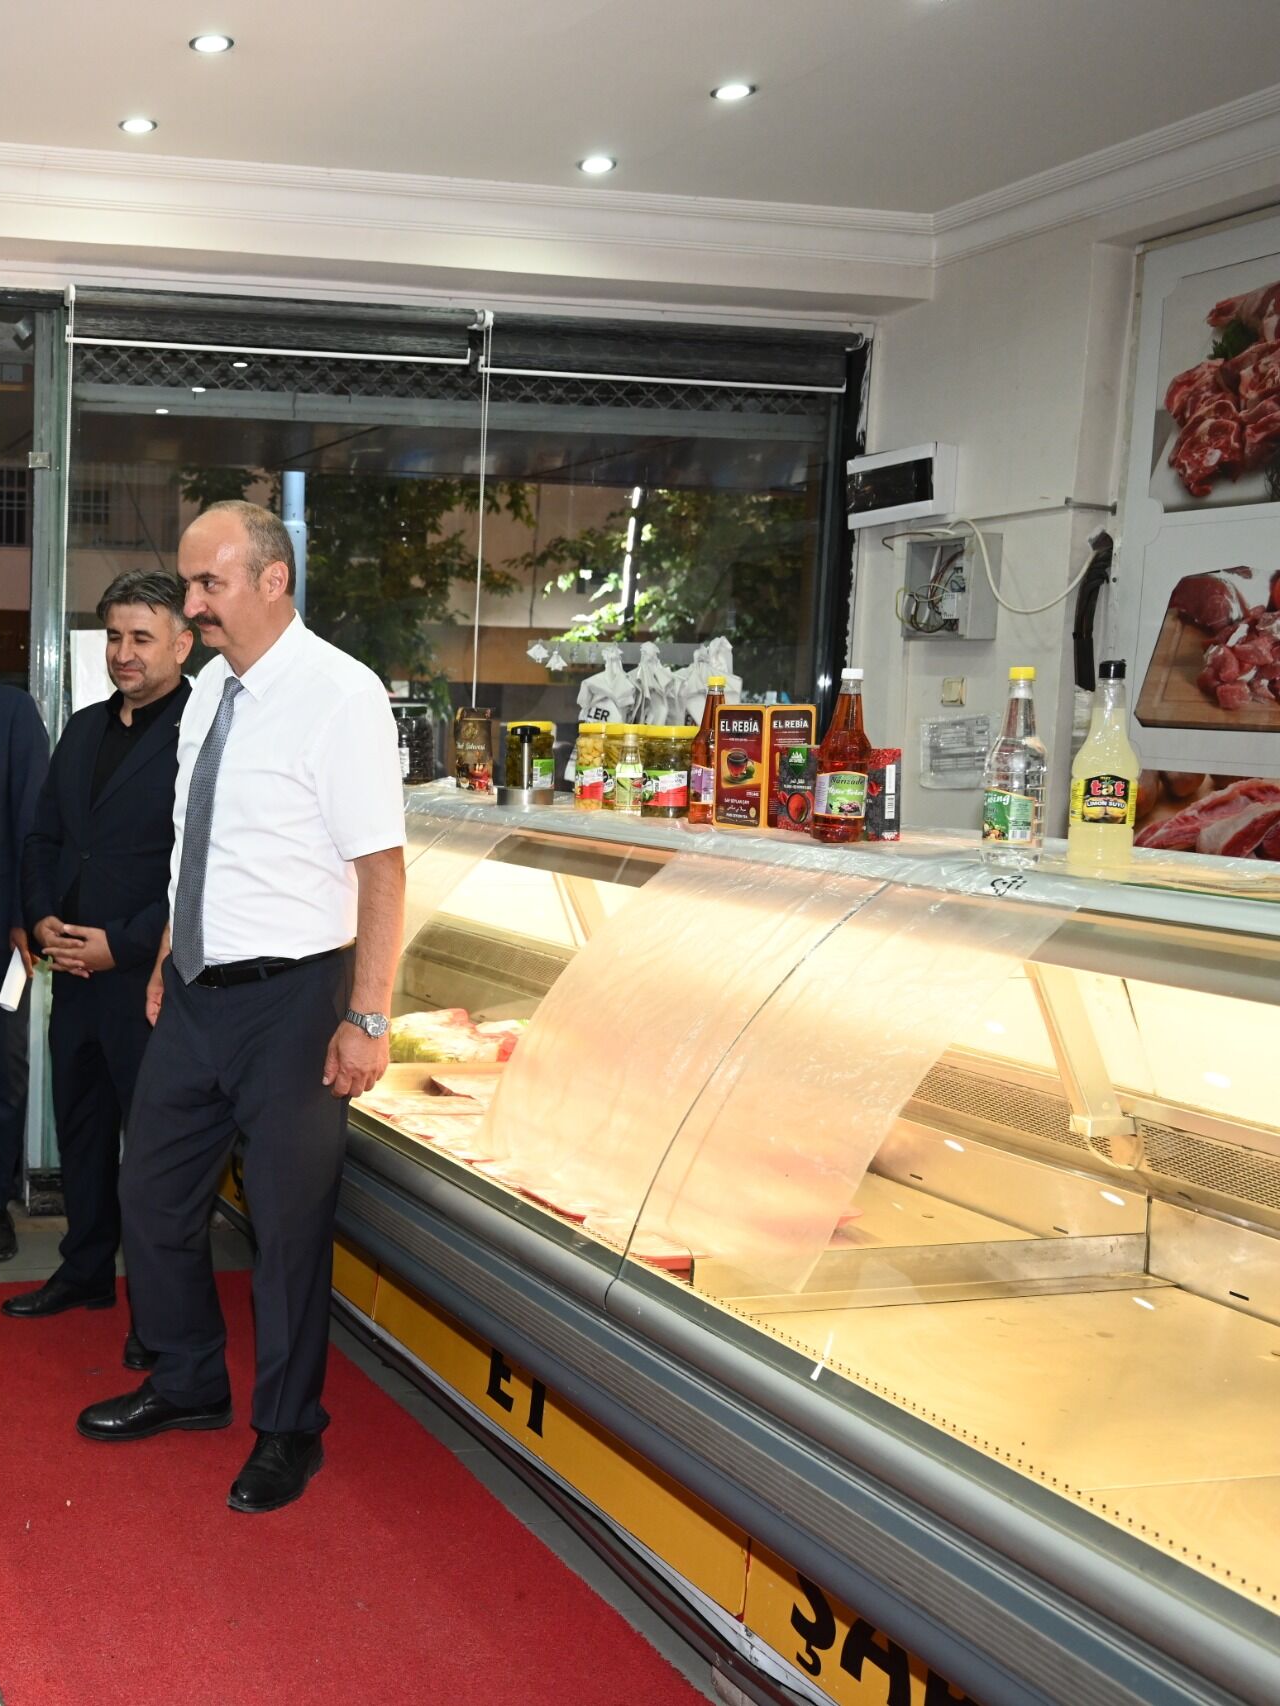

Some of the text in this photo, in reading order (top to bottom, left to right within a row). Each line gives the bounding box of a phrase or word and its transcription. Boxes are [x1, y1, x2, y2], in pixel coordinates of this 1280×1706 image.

[720, 718, 759, 733] EL REBİA
[773, 718, 809, 728] EL REBİA
[1090, 779, 1126, 796] tat
